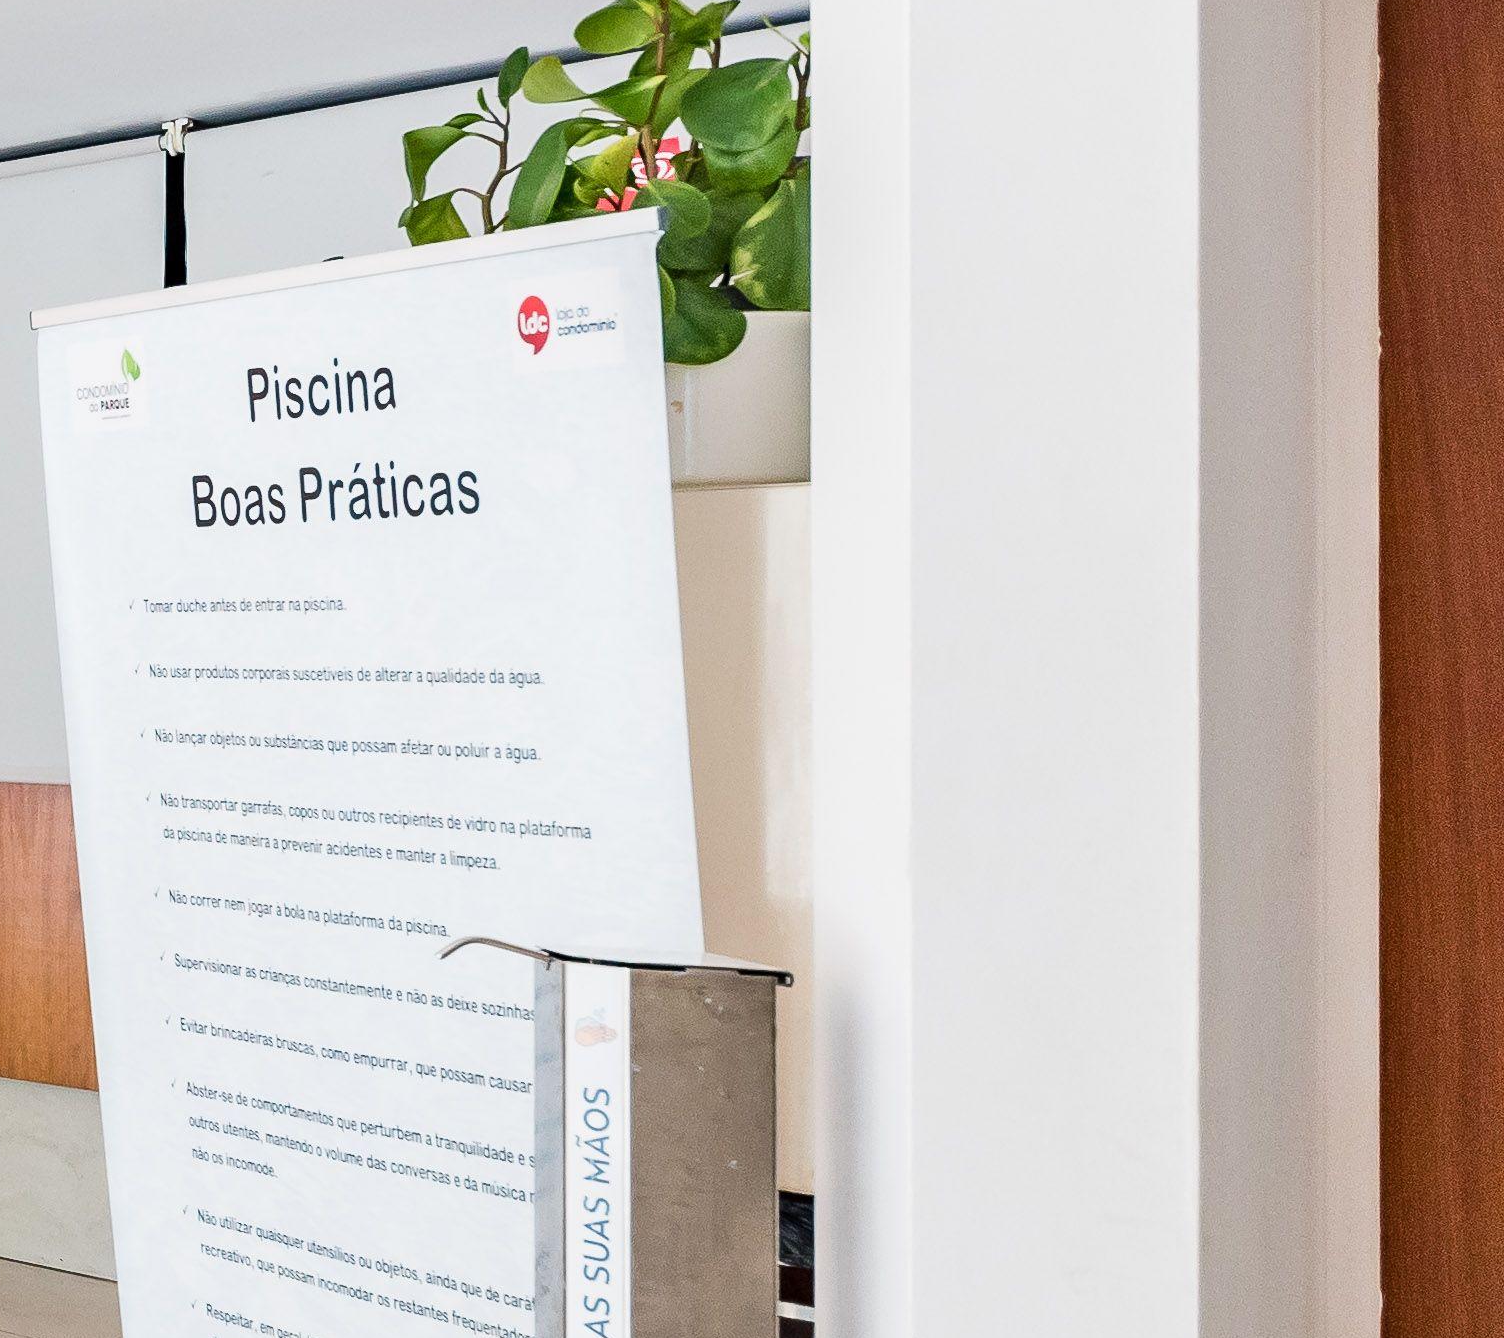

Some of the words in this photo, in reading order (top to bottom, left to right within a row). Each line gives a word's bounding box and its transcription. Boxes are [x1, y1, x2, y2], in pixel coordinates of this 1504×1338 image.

[519, 311, 548, 335] ldc
[100, 397, 130, 411] PARQUE
[247, 358, 397, 423] Piscina
[191, 473, 286, 528] Boas
[298, 460, 480, 522] Práticas
[143, 599, 174, 613] Tomar
[176, 598, 208, 613] duche
[209, 598, 238, 613] antes
[239, 598, 253, 612] de
[254, 598, 286, 611] entrar
[288, 600, 302, 611] na
[303, 599, 347, 615] piscina.
[149, 664, 169, 678] Não
[169, 667, 192, 679] usar
[194, 664, 240, 682] produtos
[241, 668, 291, 683] corporais
[356, 667, 372, 682] de
[374, 667, 413, 683] alterar
[425, 668, 486, 686] qualidade
[488, 669, 505, 684] da
[508, 672, 545, 689] água.
[154, 729, 174, 743] Não
[174, 730, 208, 747] lançar
[209, 731, 247, 749] objetos
[248, 736, 262, 747] ou
[263, 734, 325, 751] substâncias
[326, 740, 349, 755] que
[351, 740, 398, 755] possam
[400, 739, 434, 755] afetar
[436, 744, 452, 757] ou
[454, 742, 490, 760] poluir
[505, 747, 543, 764] água.
[160, 792, 180, 808] Não
[180, 795, 239, 813] transportar
[240, 800, 287, 817] garrafas,
[288, 806, 320, 821] copos
[321, 808, 336, 821] ou
[337, 807, 376, 823] outros
[378, 810, 445, 829] recipientes
[446, 814, 462, 831] de
[464, 817, 497, 833] vidro
[499, 821, 516, 835] na
[518, 819, 593, 839] plataforma
[162, 826, 176, 840] da
[176, 830, 213, 843] piscina
[214, 829, 228, 845] de
[229, 833, 271, 849] maneira
[280, 839, 323, 853] prevenir
[326, 841, 383, 859] acidentes
[395, 848, 437, 864] manter
[168, 889, 188, 904] Não
[189, 895, 222, 908] correr
[224, 899, 246, 911] nem
[247, 898, 273, 918] jogar
[283, 902, 306, 920] bola
[307, 910, 321, 922] na
[322, 909, 385, 930] plataforma
[387, 915, 403, 931] da
[405, 920, 451, 938] piscina.
[174, 952, 242, 976] Supervisionar
[245, 967, 258, 978] as
[258, 967, 302, 987] crianças
[303, 977, 393, 1000] constantemente
[406, 988, 428, 1005] não
[430, 995, 444, 1008] as
[446, 995, 479, 1014] deixe
[179, 1017, 208, 1035] Evitar
[210, 1023, 274, 1047] brincadeiras
[275, 1034, 319, 1057] bruscas,
[320, 1047, 351, 1062] como
[352, 1053, 413, 1075] empurrar,
[415, 1063, 437, 1078] que
[439, 1067, 486, 1086] possam
[488, 1075, 534, 1094] causar
[575, 1089, 611, 1184] MÃOS
[191, 1146, 210, 1162] não
[211, 1153, 224, 1165] os
[225, 1156, 278, 1178] incomode.
[581, 1198, 612, 1283] SUAS
